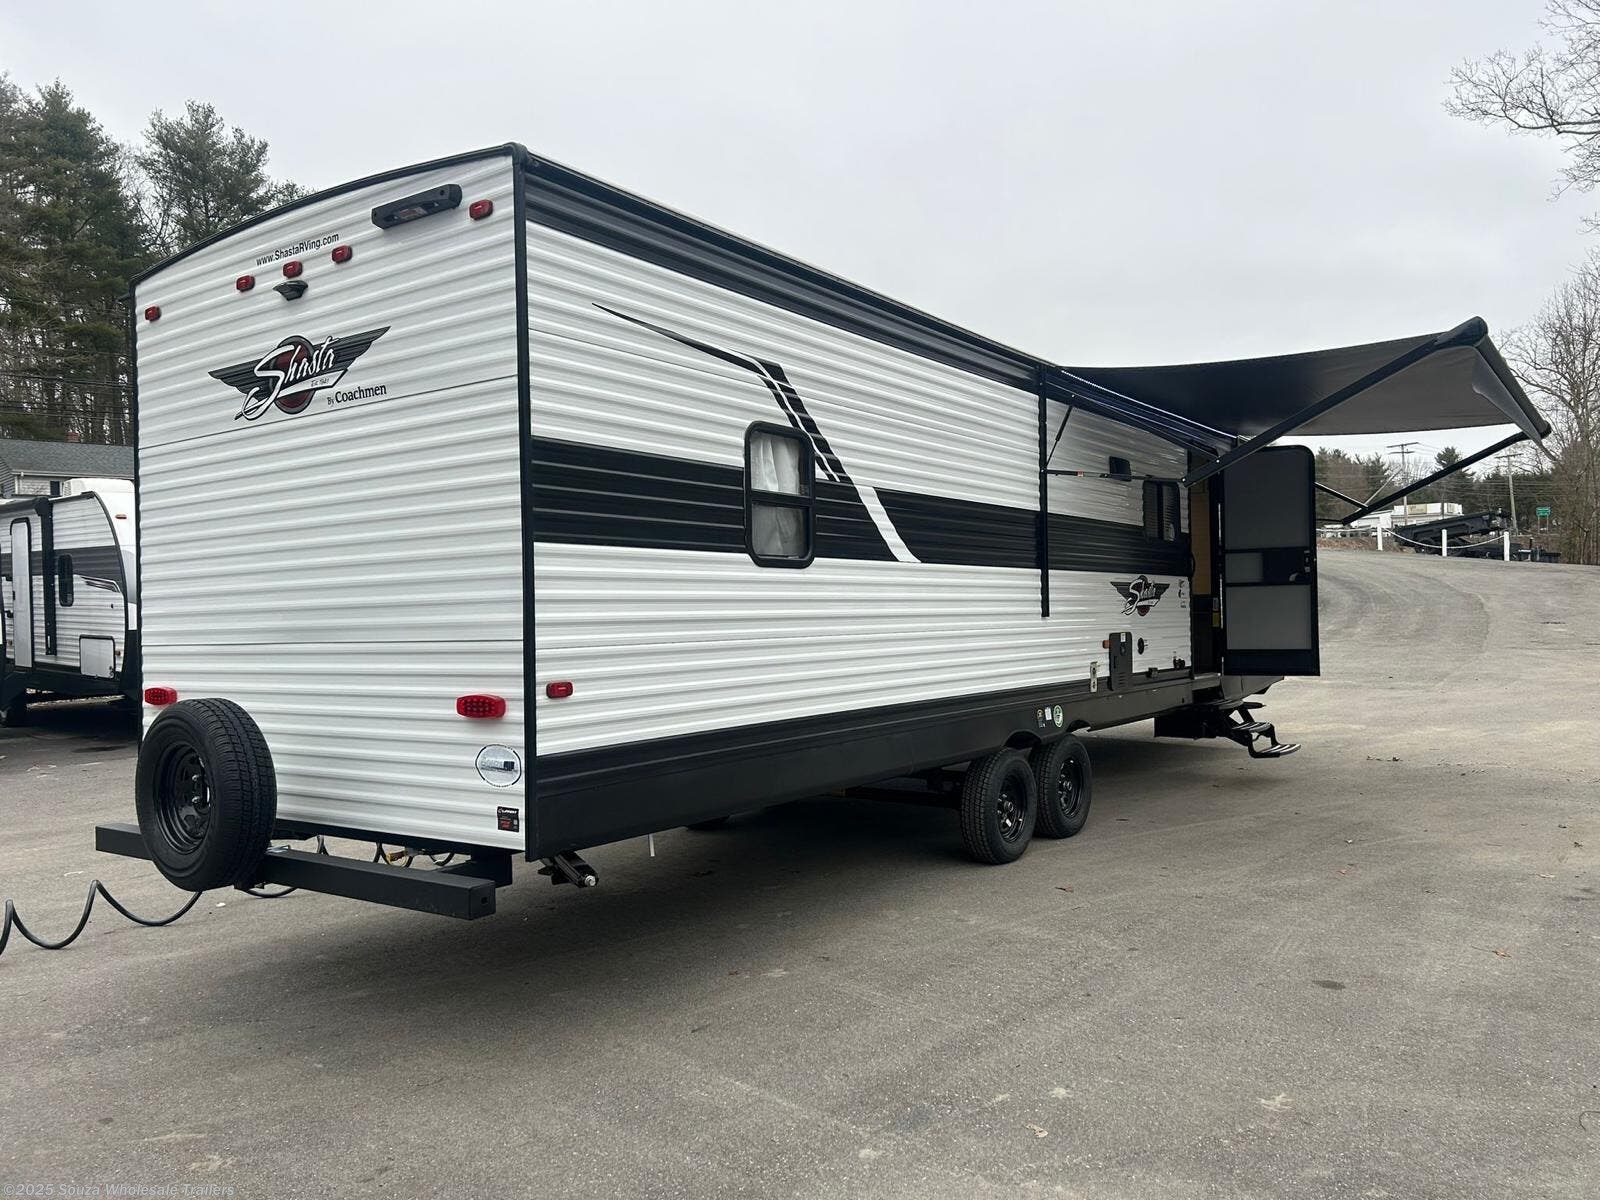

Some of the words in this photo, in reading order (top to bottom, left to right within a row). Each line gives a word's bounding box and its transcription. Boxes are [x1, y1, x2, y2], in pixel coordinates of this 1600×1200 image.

[256, 233, 339, 266] www.ShastaRVing.com
[234, 336, 342, 421] Shasta
[326, 396, 335, 407] By
[334, 384, 387, 404] Coachmen
